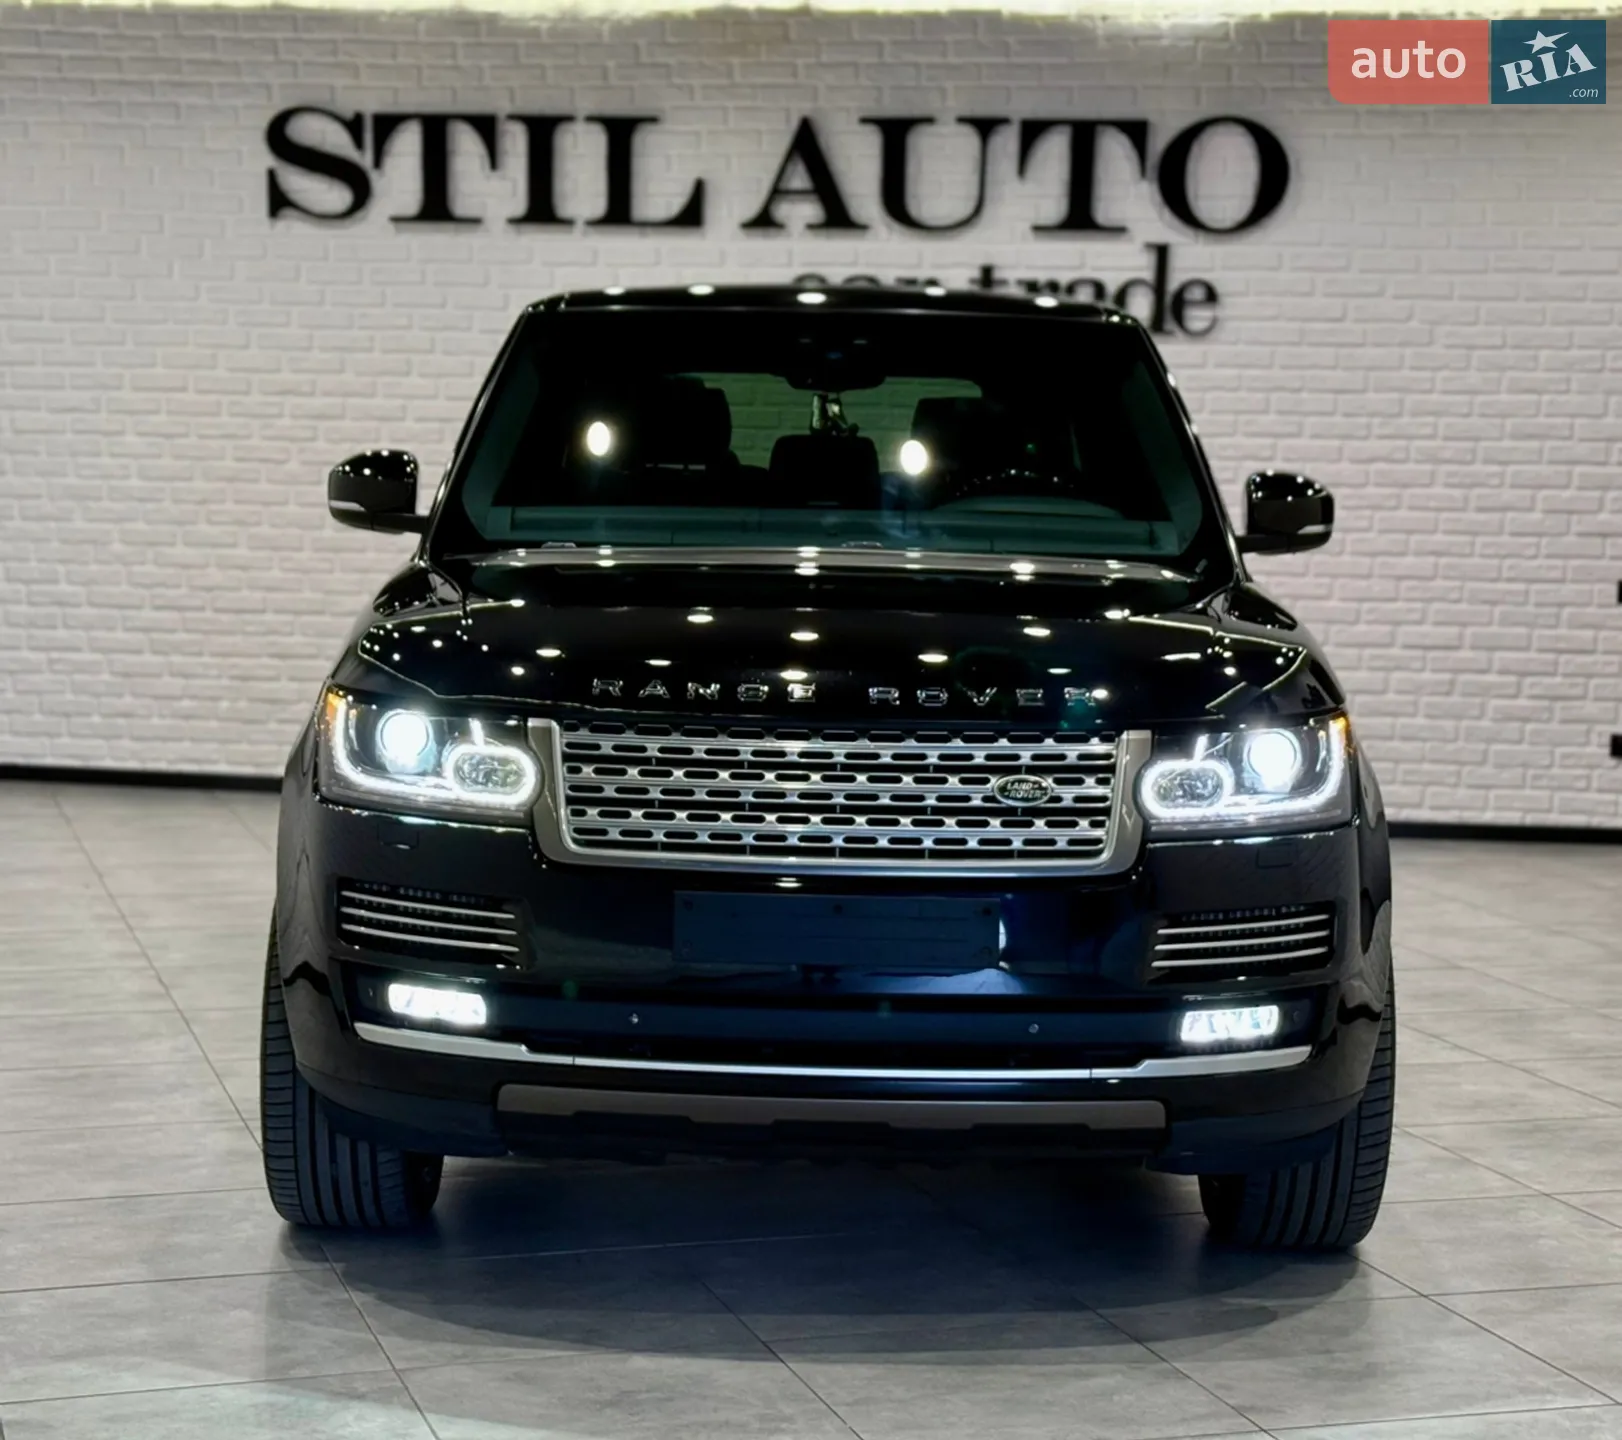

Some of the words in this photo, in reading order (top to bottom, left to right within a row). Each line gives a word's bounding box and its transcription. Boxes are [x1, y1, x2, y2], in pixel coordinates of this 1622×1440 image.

[266, 106, 706, 227] STIL
[740, 116, 1290, 234] AUTO
[592, 678, 816, 702] RANGE
[868, 686, 1097, 707] ROVER
[1006, 782, 1033, 791] LAND
